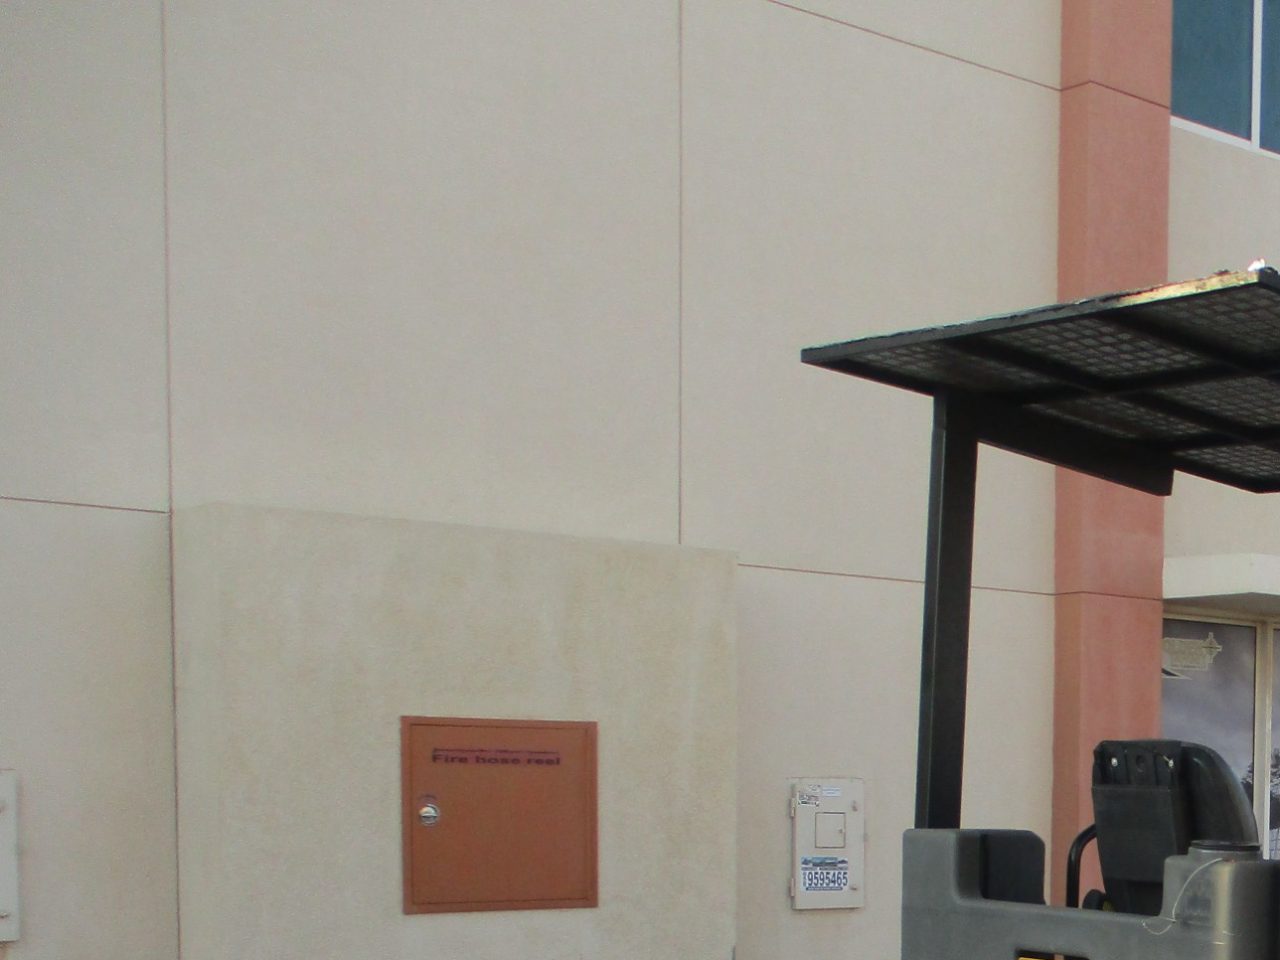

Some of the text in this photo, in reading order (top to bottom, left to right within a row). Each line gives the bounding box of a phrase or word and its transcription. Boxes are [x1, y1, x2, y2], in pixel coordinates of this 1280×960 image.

[432, 754, 561, 766] Fire hose reel
[807, 871, 848, 887] 9595465
